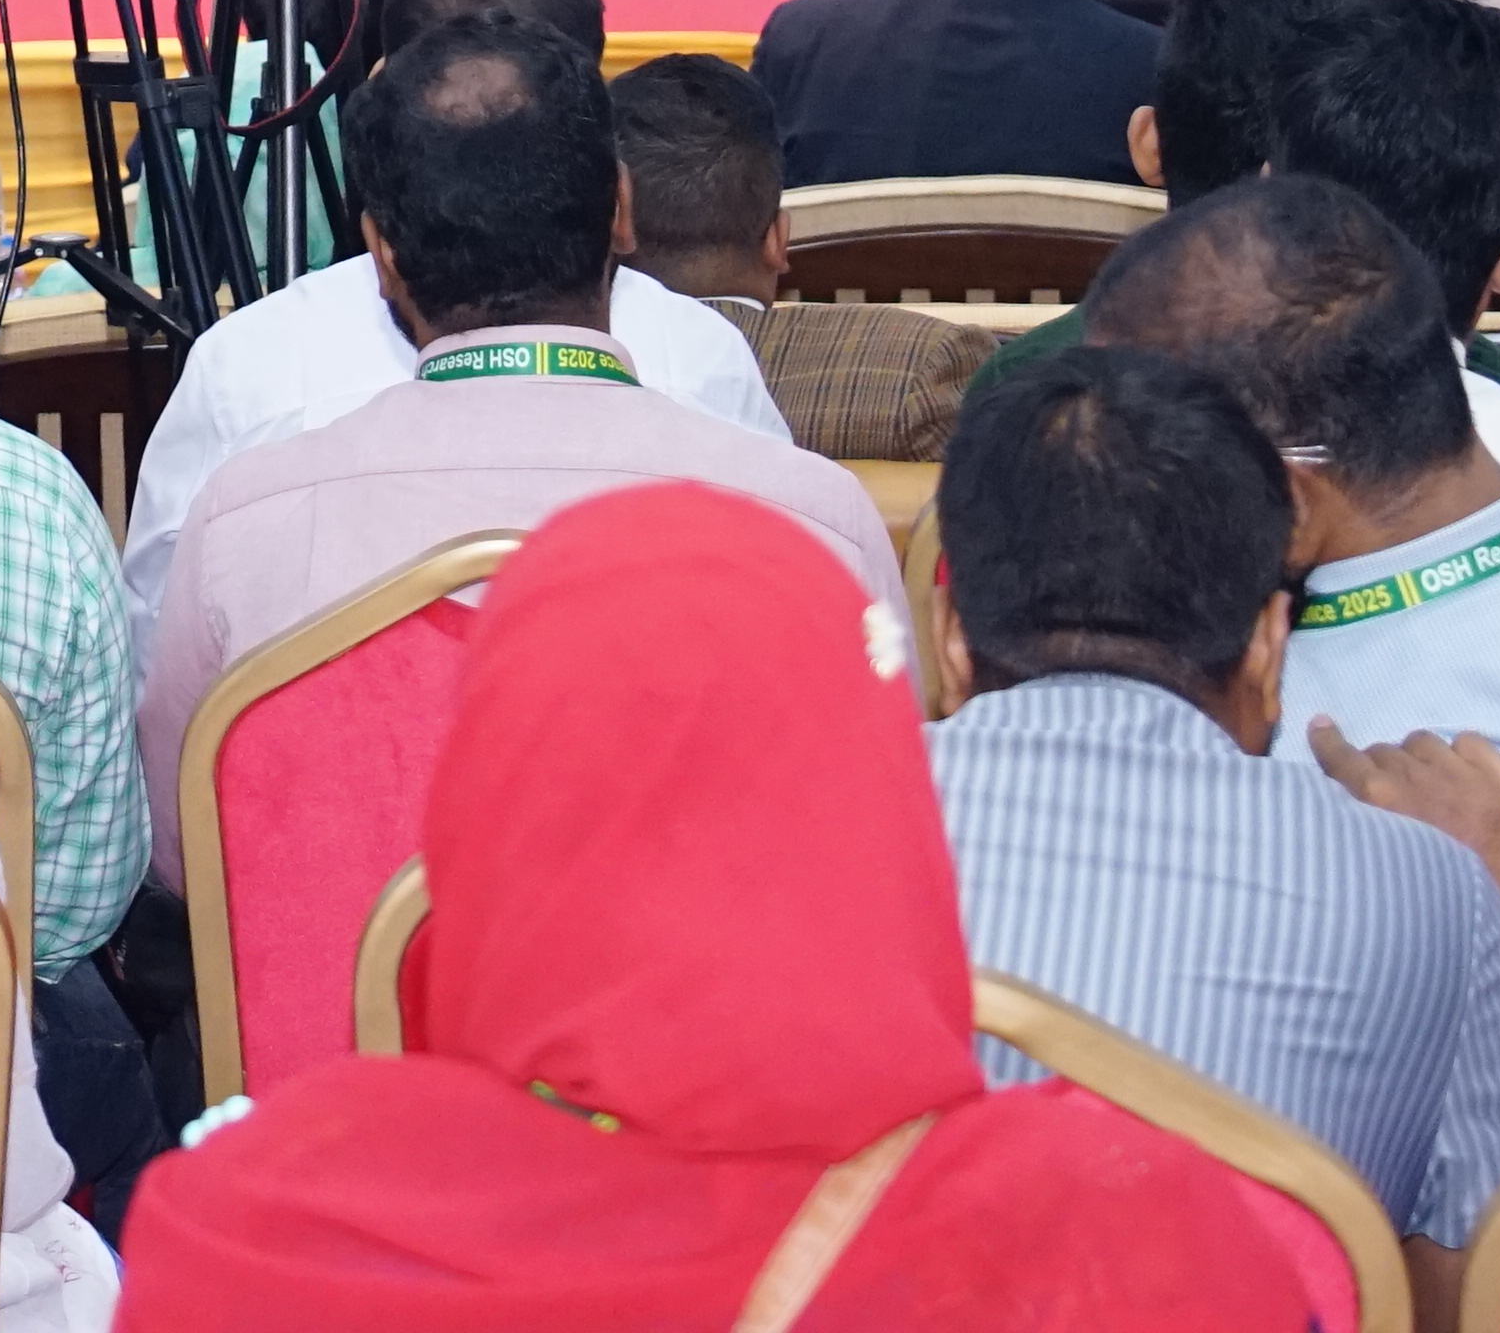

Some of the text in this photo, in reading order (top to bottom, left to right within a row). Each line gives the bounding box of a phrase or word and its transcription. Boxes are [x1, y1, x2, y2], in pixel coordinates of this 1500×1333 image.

[489, 347, 530, 368] OSH
[558, 347, 597, 370] 2025
[1338, 585, 1392, 618] 2025
[1420, 554, 1473, 594] OSH
